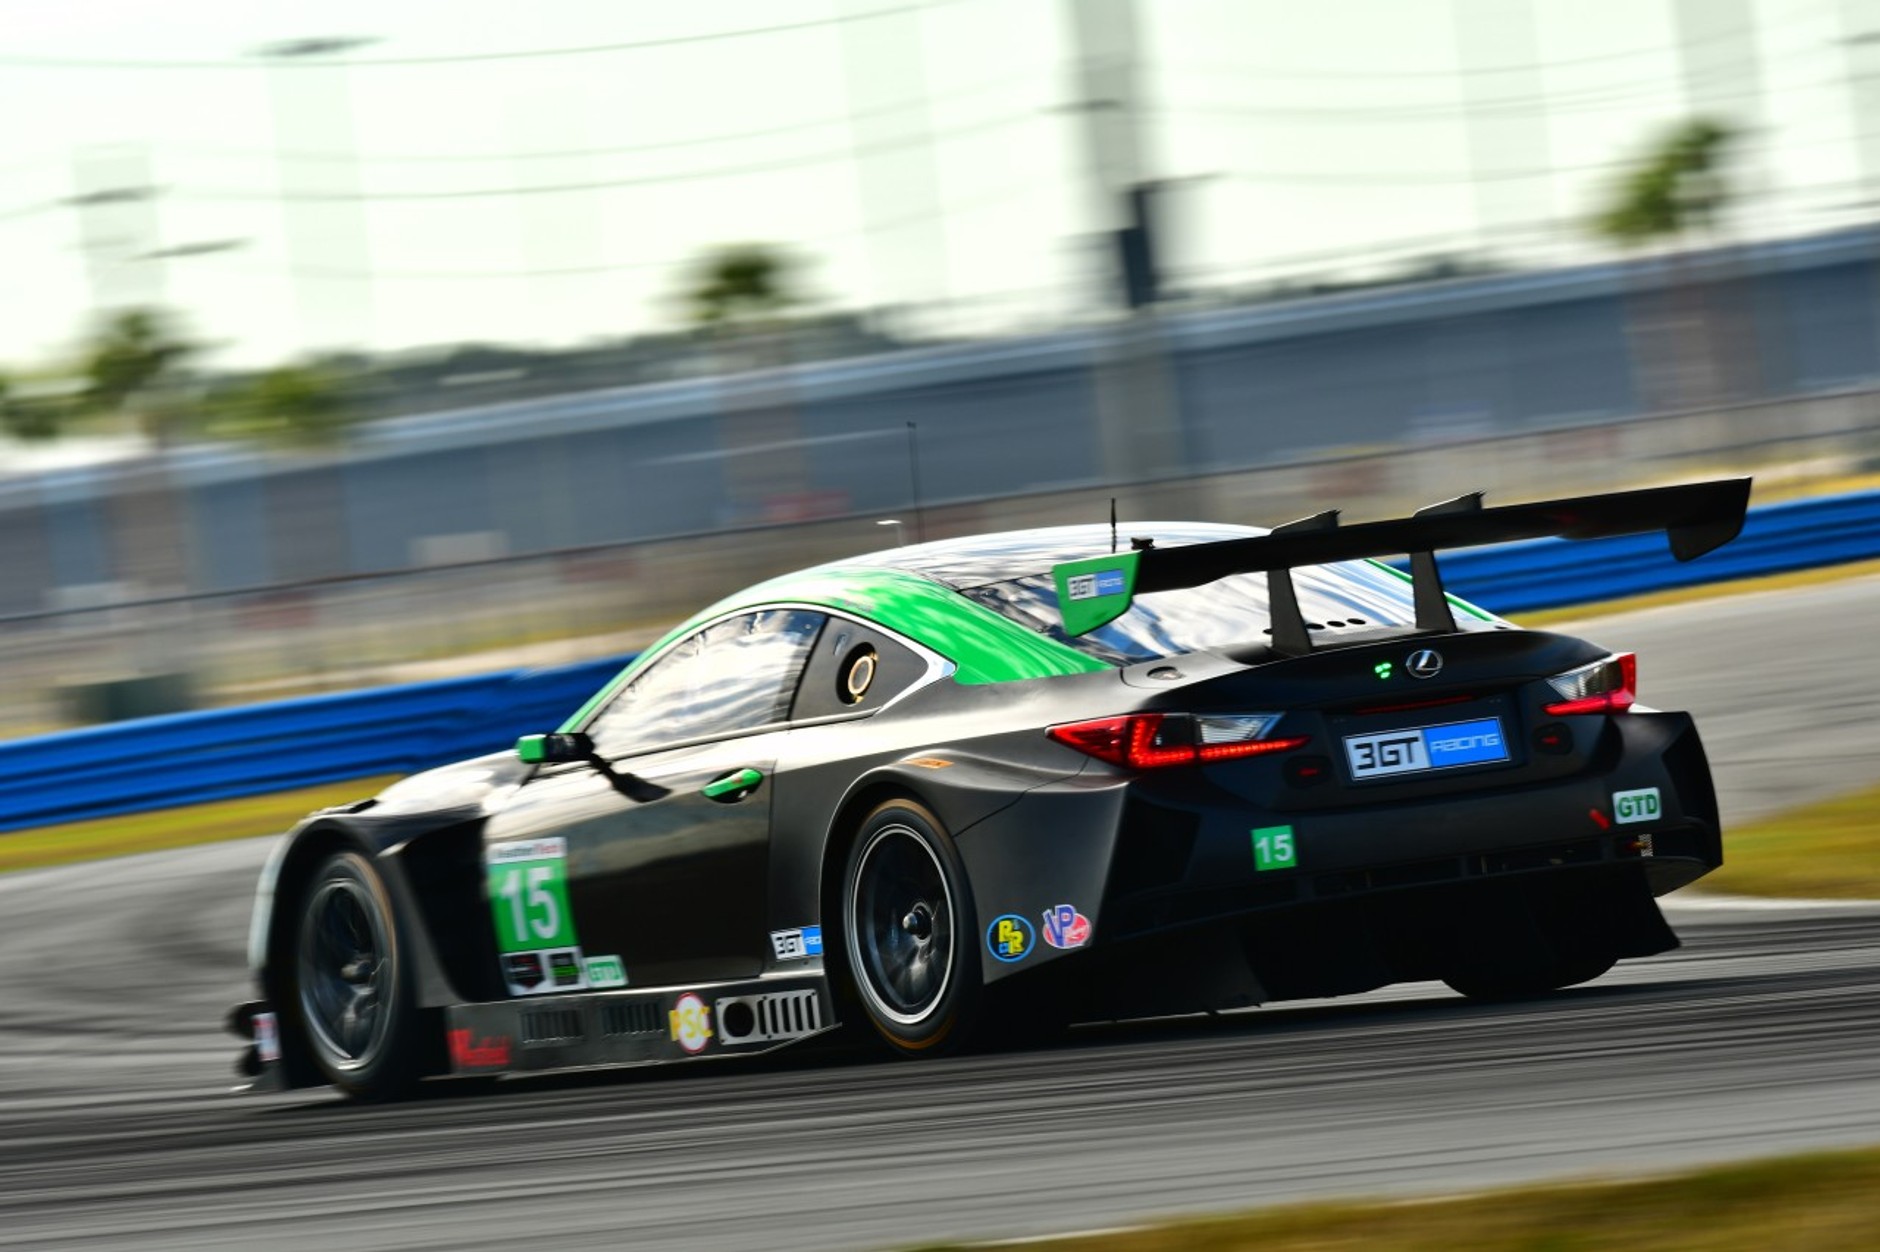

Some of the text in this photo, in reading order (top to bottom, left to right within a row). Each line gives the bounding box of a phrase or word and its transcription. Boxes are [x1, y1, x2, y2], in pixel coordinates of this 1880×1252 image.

[1354, 736, 1420, 770] 3GT
[1618, 793, 1659, 818] GTD
[1254, 833, 1294, 863] 15
[500, 865, 560, 942] 15
[1042, 904, 1077, 948] VP
[775, 933, 801, 955] 3GT
